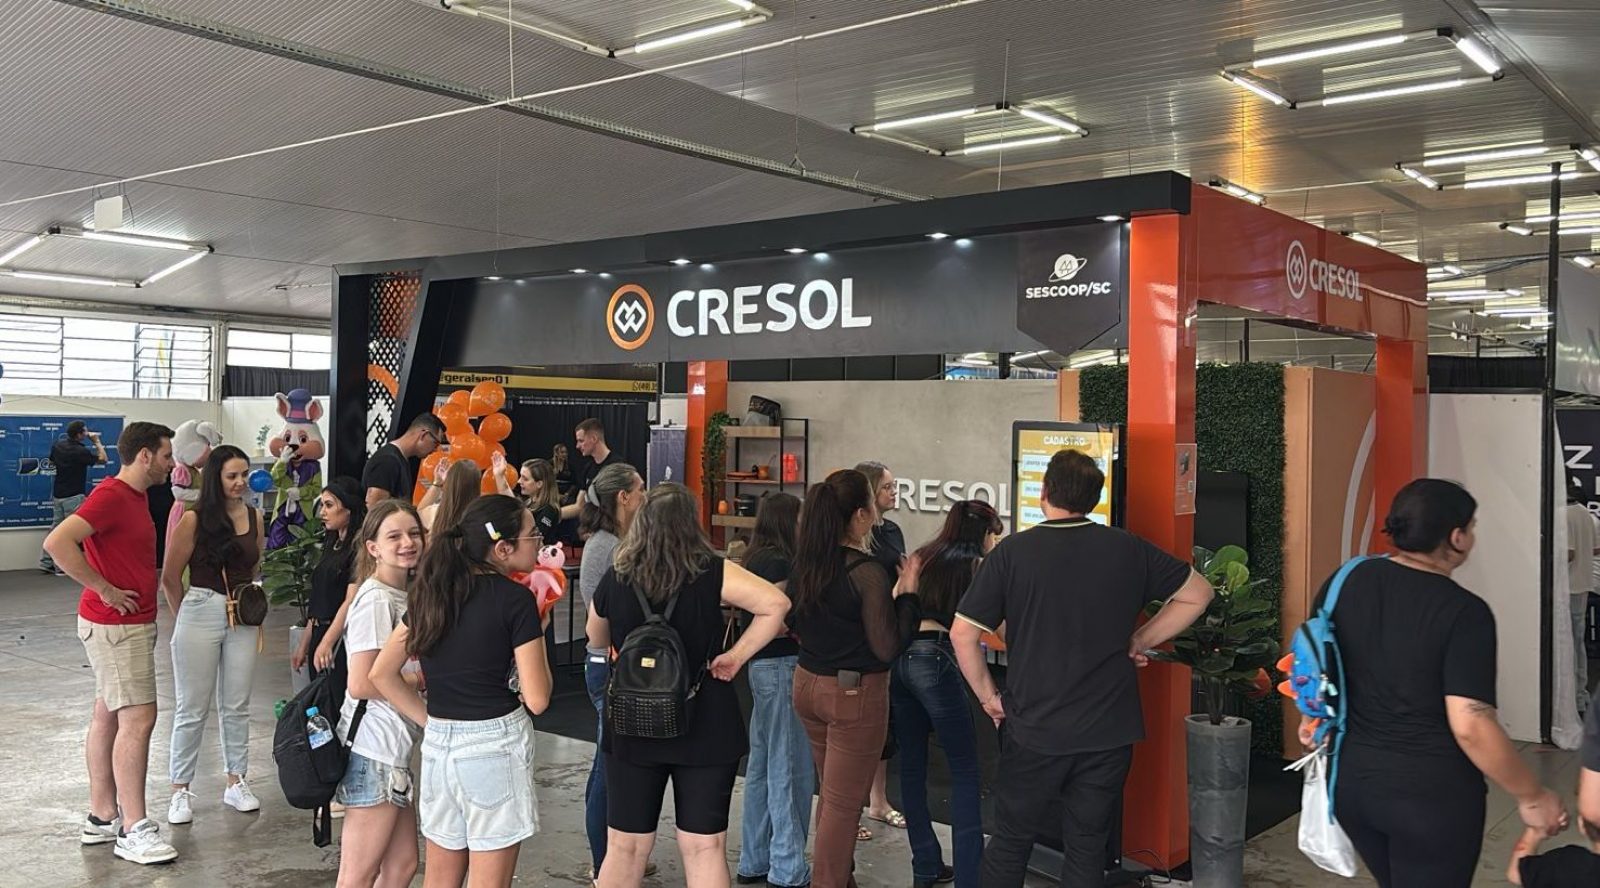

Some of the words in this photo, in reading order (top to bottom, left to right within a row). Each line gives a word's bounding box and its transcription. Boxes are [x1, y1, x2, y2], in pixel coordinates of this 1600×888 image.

[1025, 281, 1111, 299] SESCOOP/SC
[1309, 258, 1363, 302] CRESOL
[667, 277, 872, 337] CRESOL
[1043, 435, 1085, 446] CADASTRO
[893, 477, 1011, 517] RESOL
